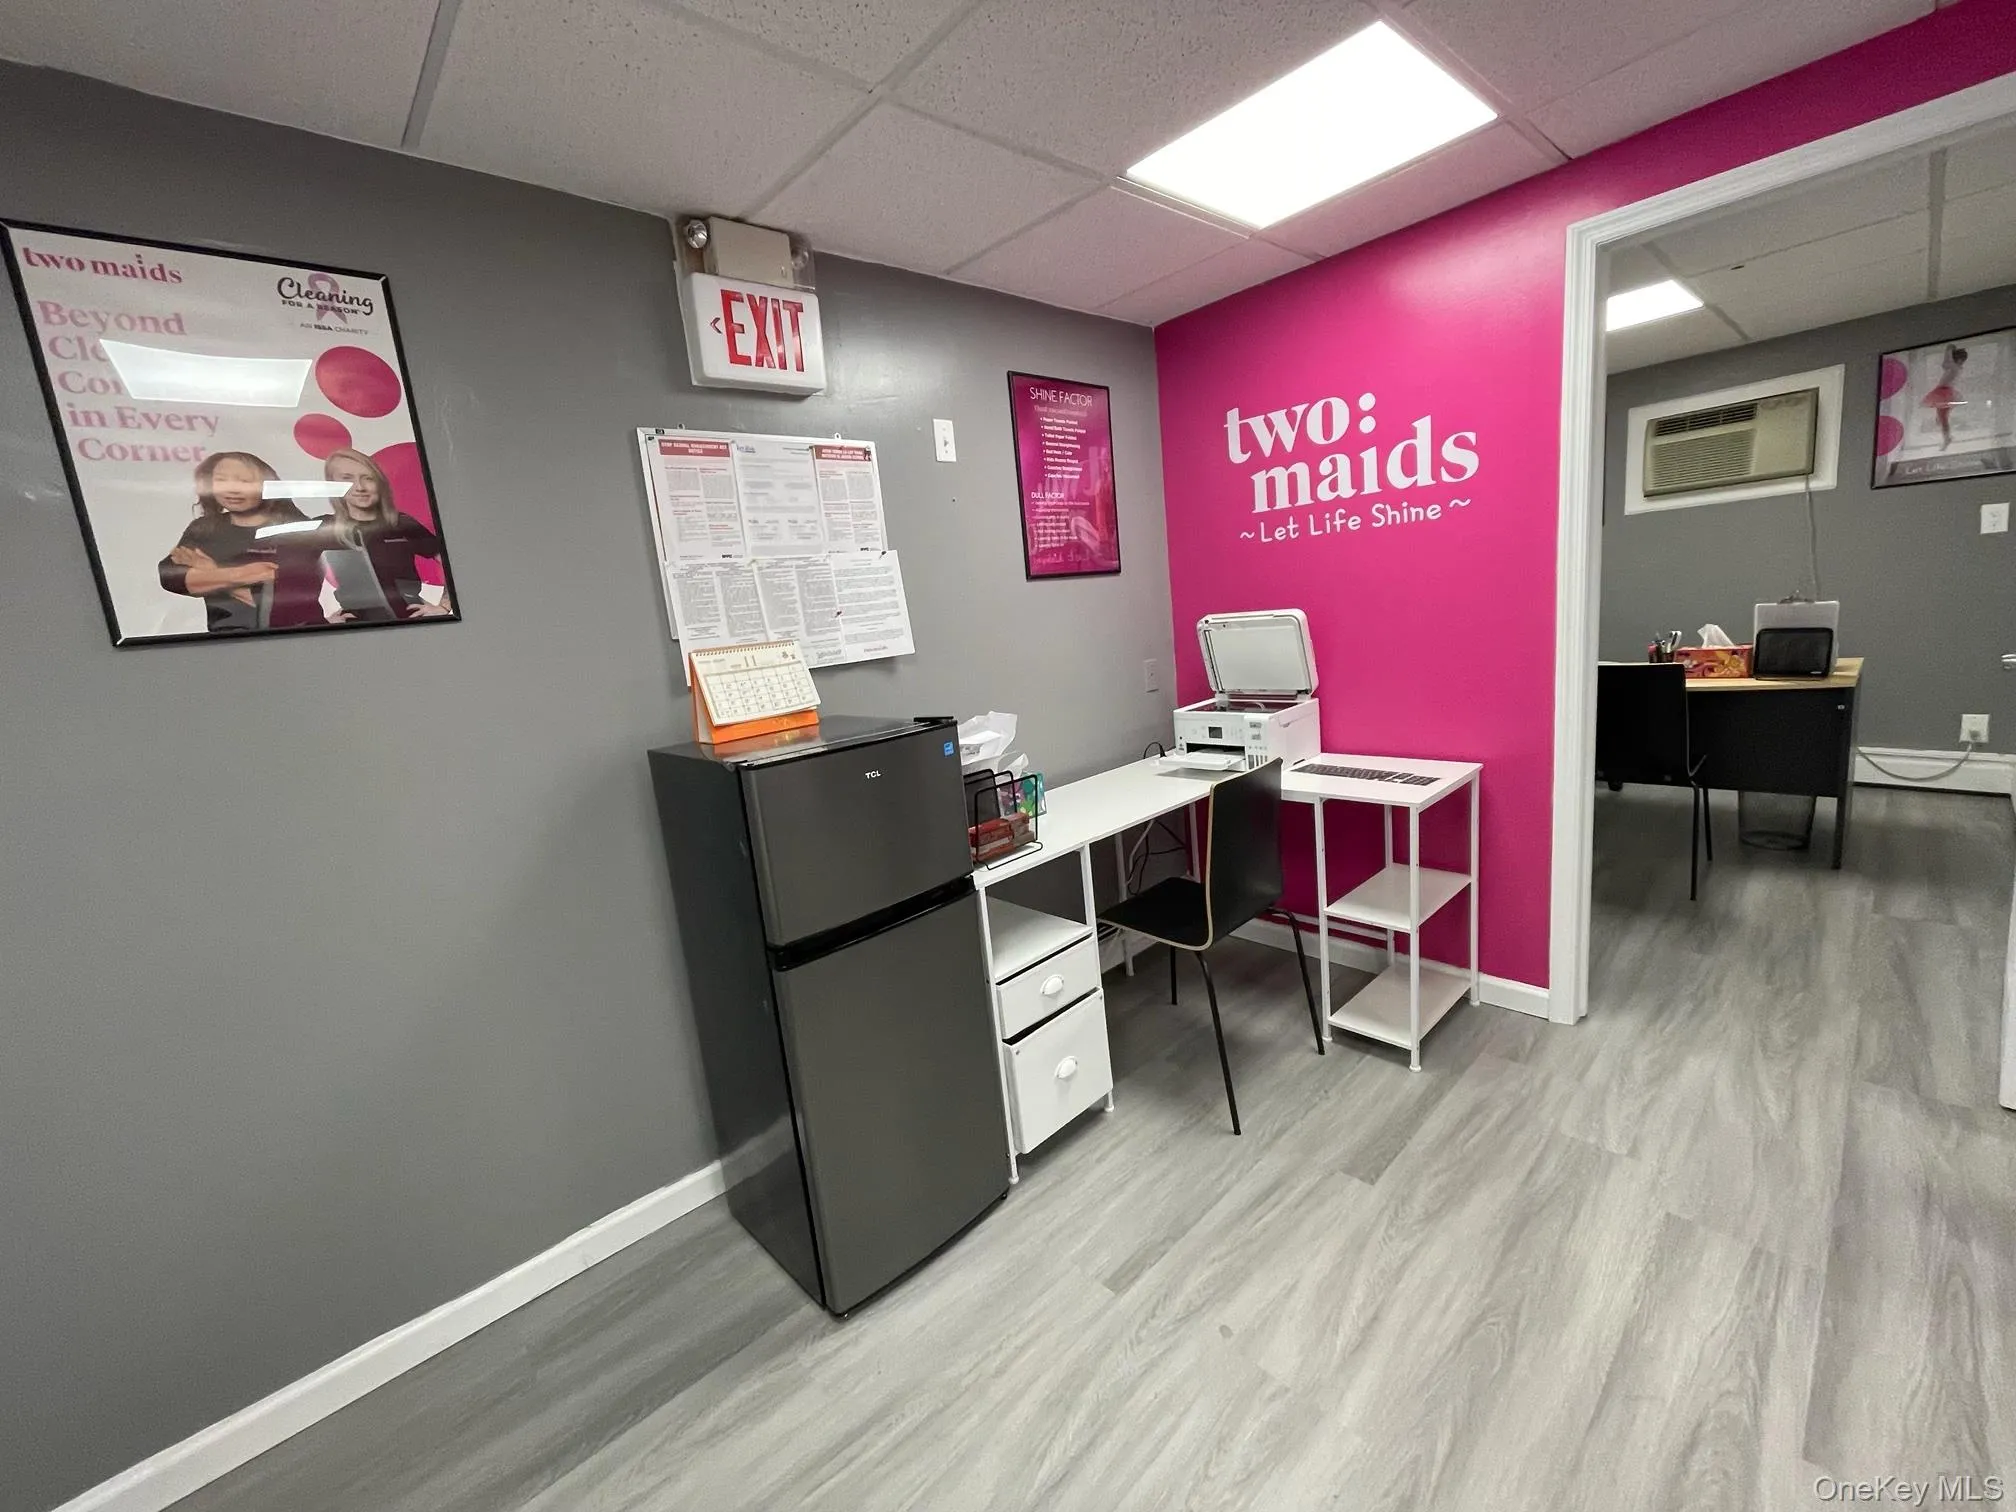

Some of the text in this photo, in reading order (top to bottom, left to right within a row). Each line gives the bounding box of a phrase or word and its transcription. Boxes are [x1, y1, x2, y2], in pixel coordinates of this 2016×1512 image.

[23, 247, 183, 284] two maids
[278, 277, 373, 315] Cleaning
[281, 300, 303, 308] FOR
[317, 304, 359, 314] REASON
[38, 300, 187, 335] Beyond
[721, 289, 804, 372] EXIT
[1030, 387, 1092, 406] SHINE FACTOR
[66, 402, 220, 437] in Every
[78, 437, 208, 462] Corner
[1251, 415, 1480, 513] maids
[1260, 502, 1441, 543] Let Life Shine
[865, 770, 881, 779] TCL
